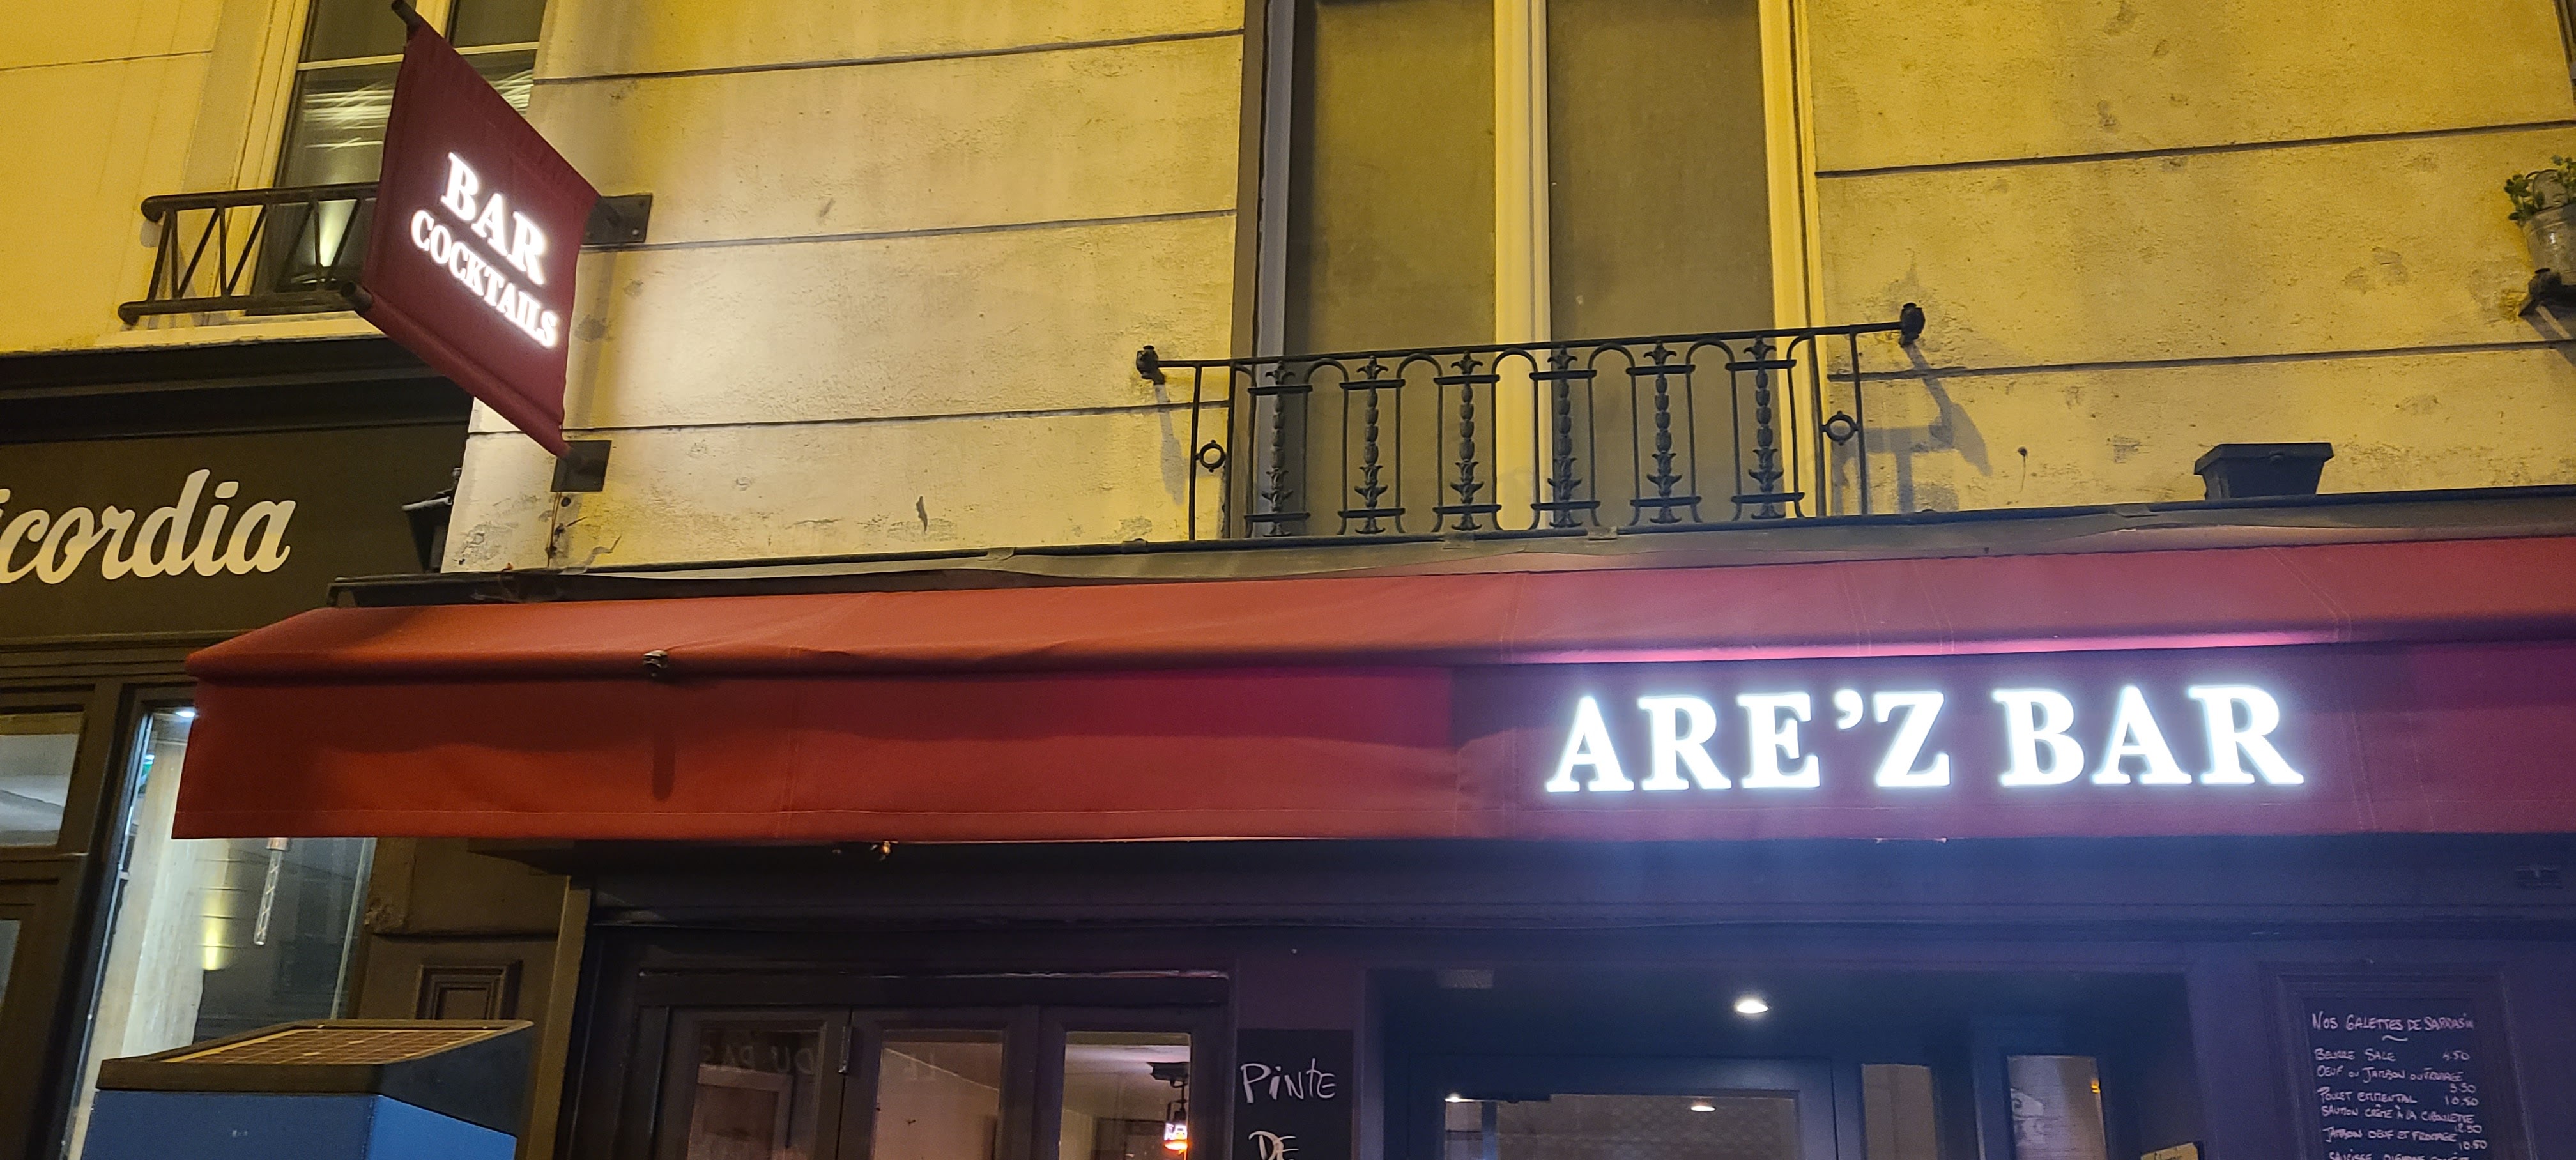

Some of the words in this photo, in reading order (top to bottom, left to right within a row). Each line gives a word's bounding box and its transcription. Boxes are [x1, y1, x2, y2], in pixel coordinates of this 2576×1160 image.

[440, 151, 547, 285] BAR
[411, 210, 558, 349] COCKTAILS
[0, 469, 296, 584] cordia
[1545, 688, 1951, 793] ARE'Z
[1992, 684, 2304, 786] BAR
[2345, 1014, 2404, 1031] GALETTES
[2407, 1019, 2422, 1031] DE
